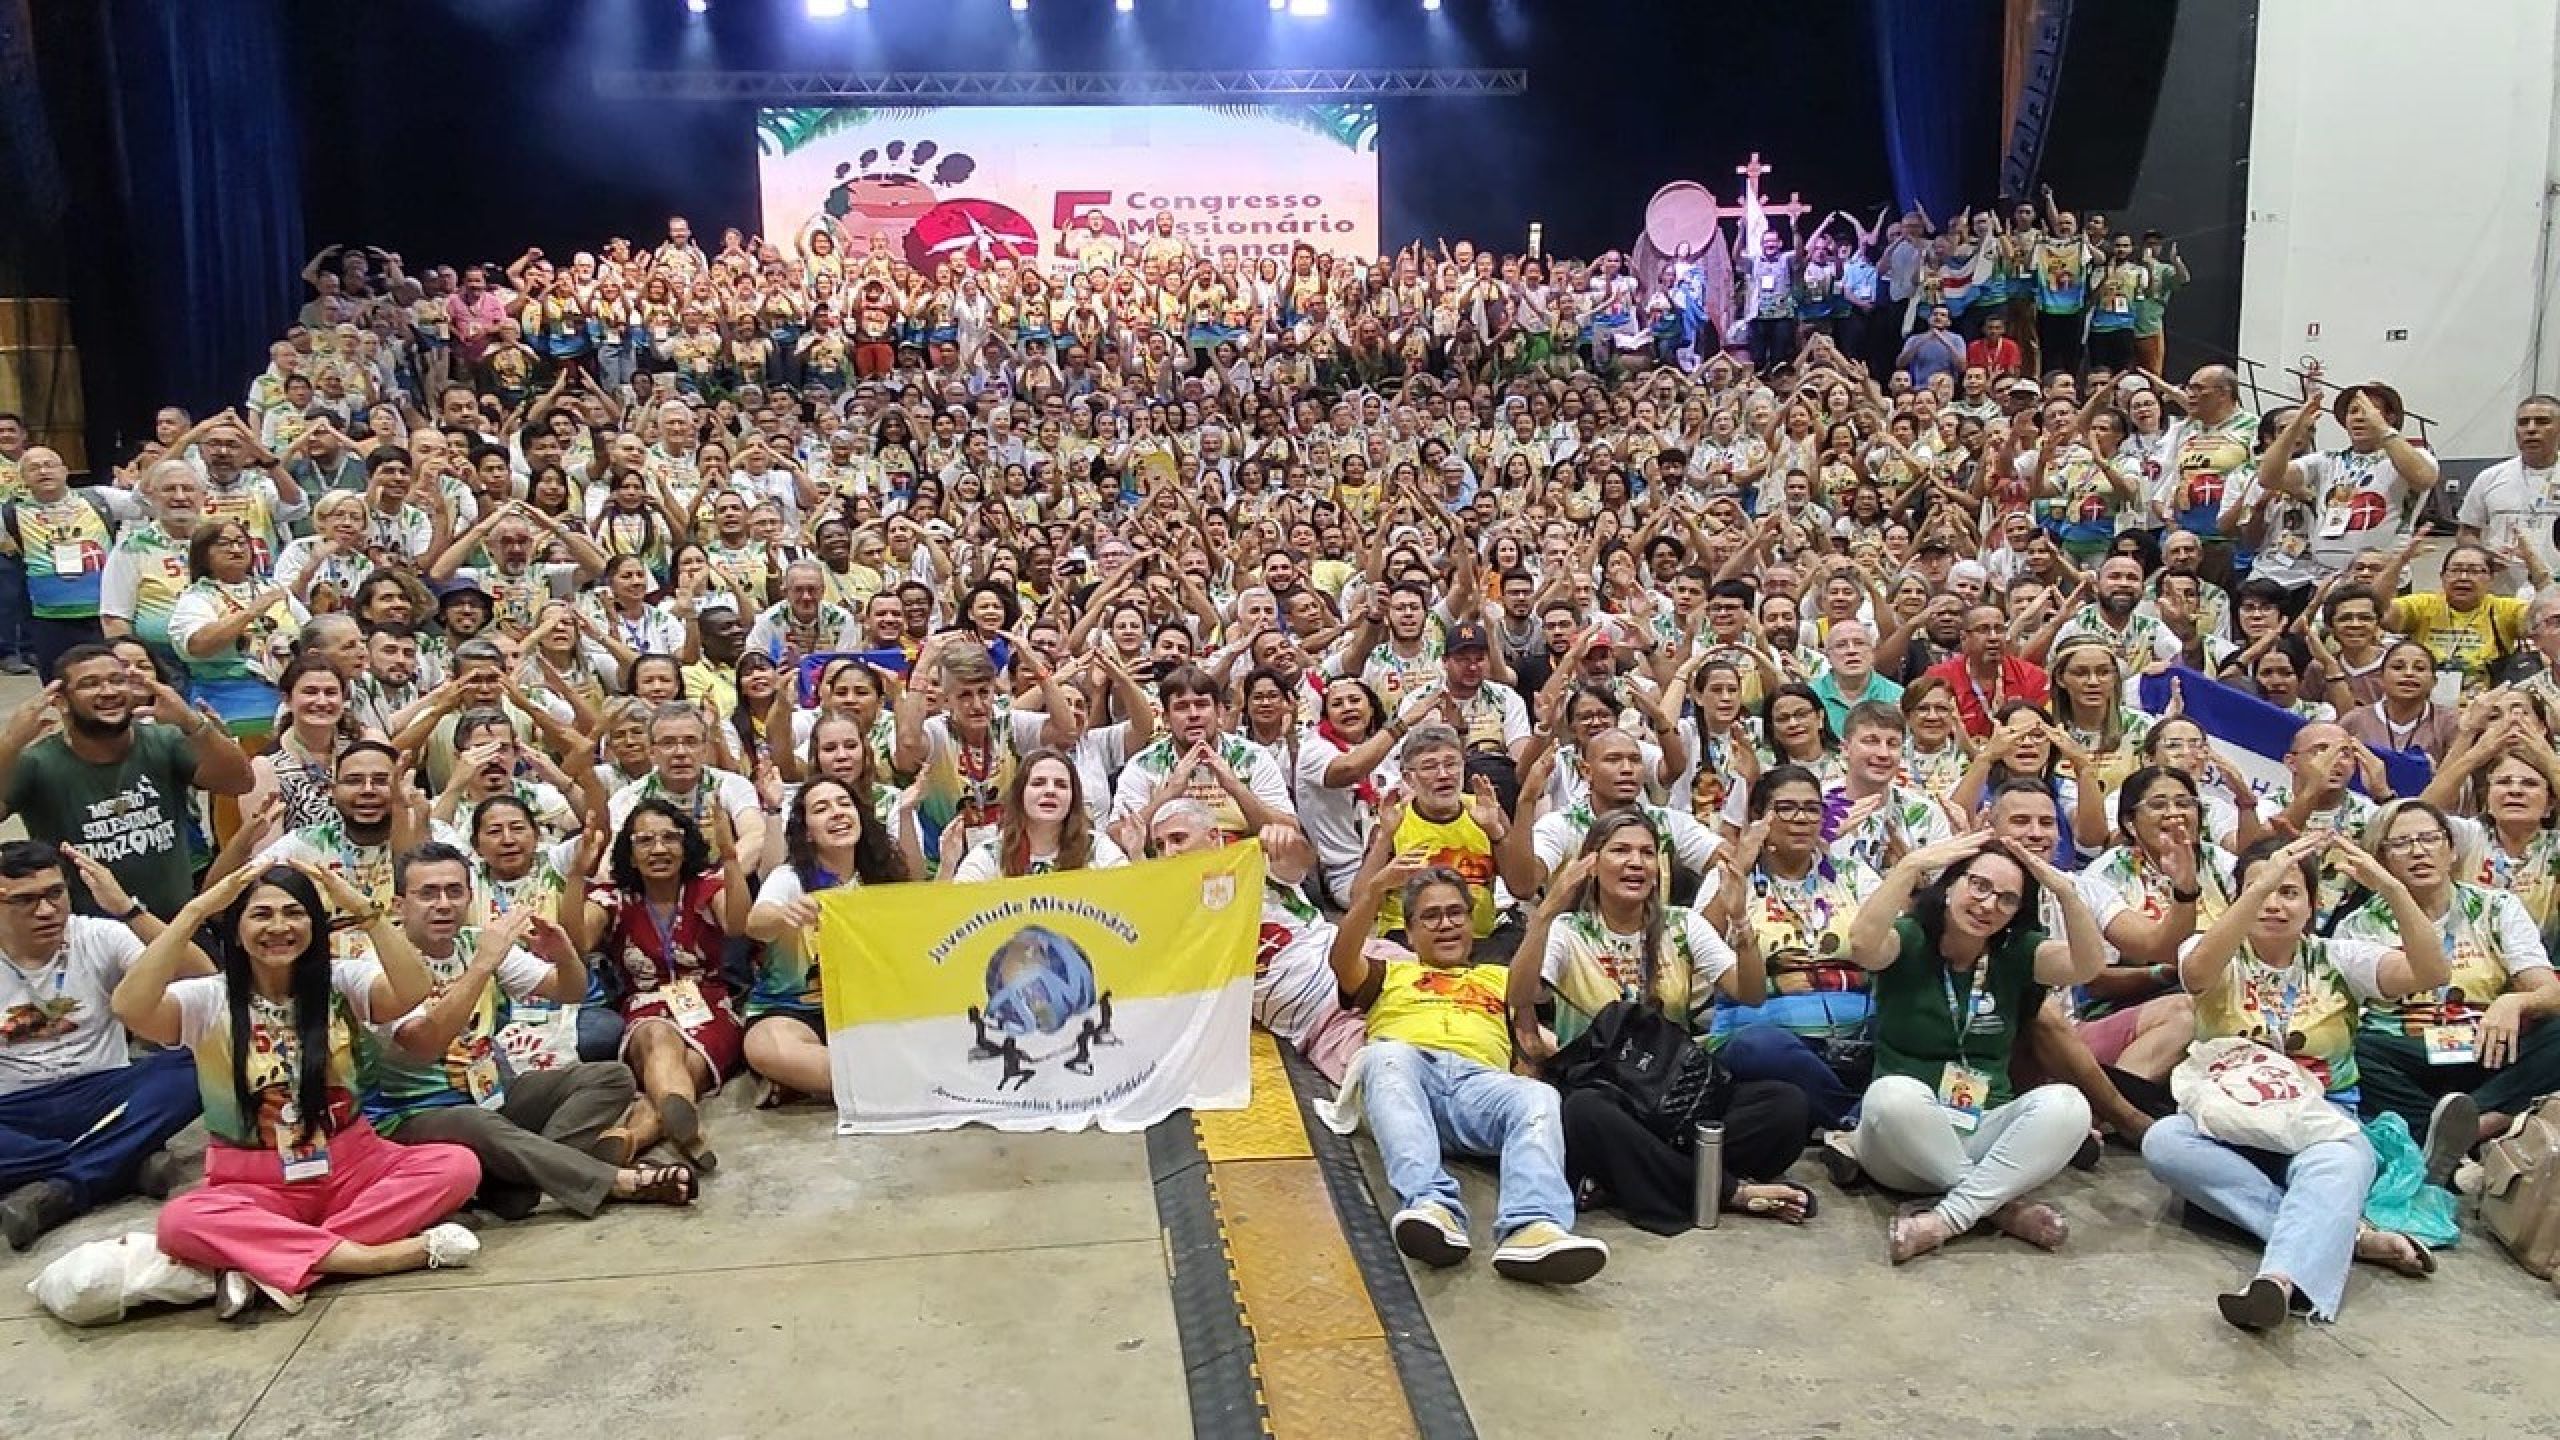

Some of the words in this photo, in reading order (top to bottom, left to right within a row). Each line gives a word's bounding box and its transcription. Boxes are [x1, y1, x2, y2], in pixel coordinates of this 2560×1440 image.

[1127, 192, 1323, 214] Congresso
[1054, 189, 1125, 259] 5
[1127, 214, 1355, 235] Mssionário
[163, 557, 181, 577] 5
[492, 585, 504, 601] 5
[1665, 641, 1676, 659] 5
[1387, 671, 1401, 691] 5
[2475, 857, 2494, 885] 5
[2143, 895, 2162, 921] 5
[927, 900, 1024, 965] Juventude
[1029, 896, 1139, 944] Missionária
[2244, 980, 2259, 1012] 5
